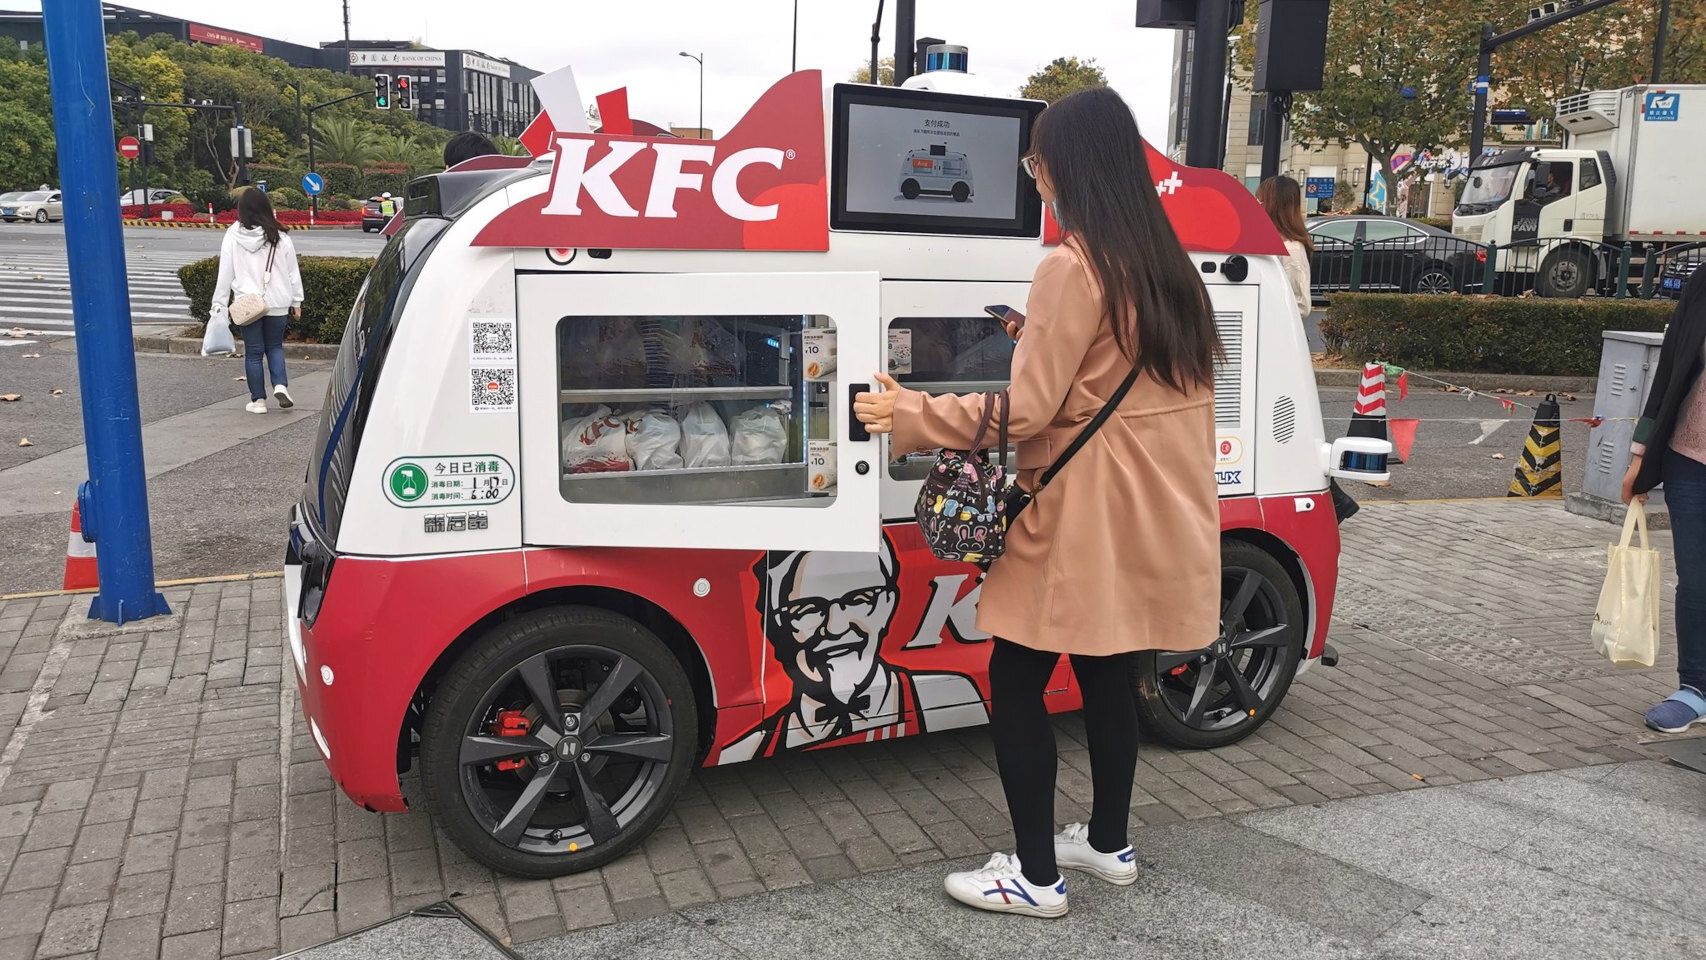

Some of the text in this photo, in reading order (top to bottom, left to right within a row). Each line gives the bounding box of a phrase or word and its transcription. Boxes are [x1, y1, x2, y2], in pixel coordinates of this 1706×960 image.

[361, 51, 400, 63] 中国银行
[924, 119, 951, 129] 支付成功
[540, 137, 785, 222] KFC
[1513, 224, 1537, 232] FAW
[435, 461, 500, 474] 今日已消毒
[1215, 471, 1242, 485] LIX
[900, 572, 990, 651] K
